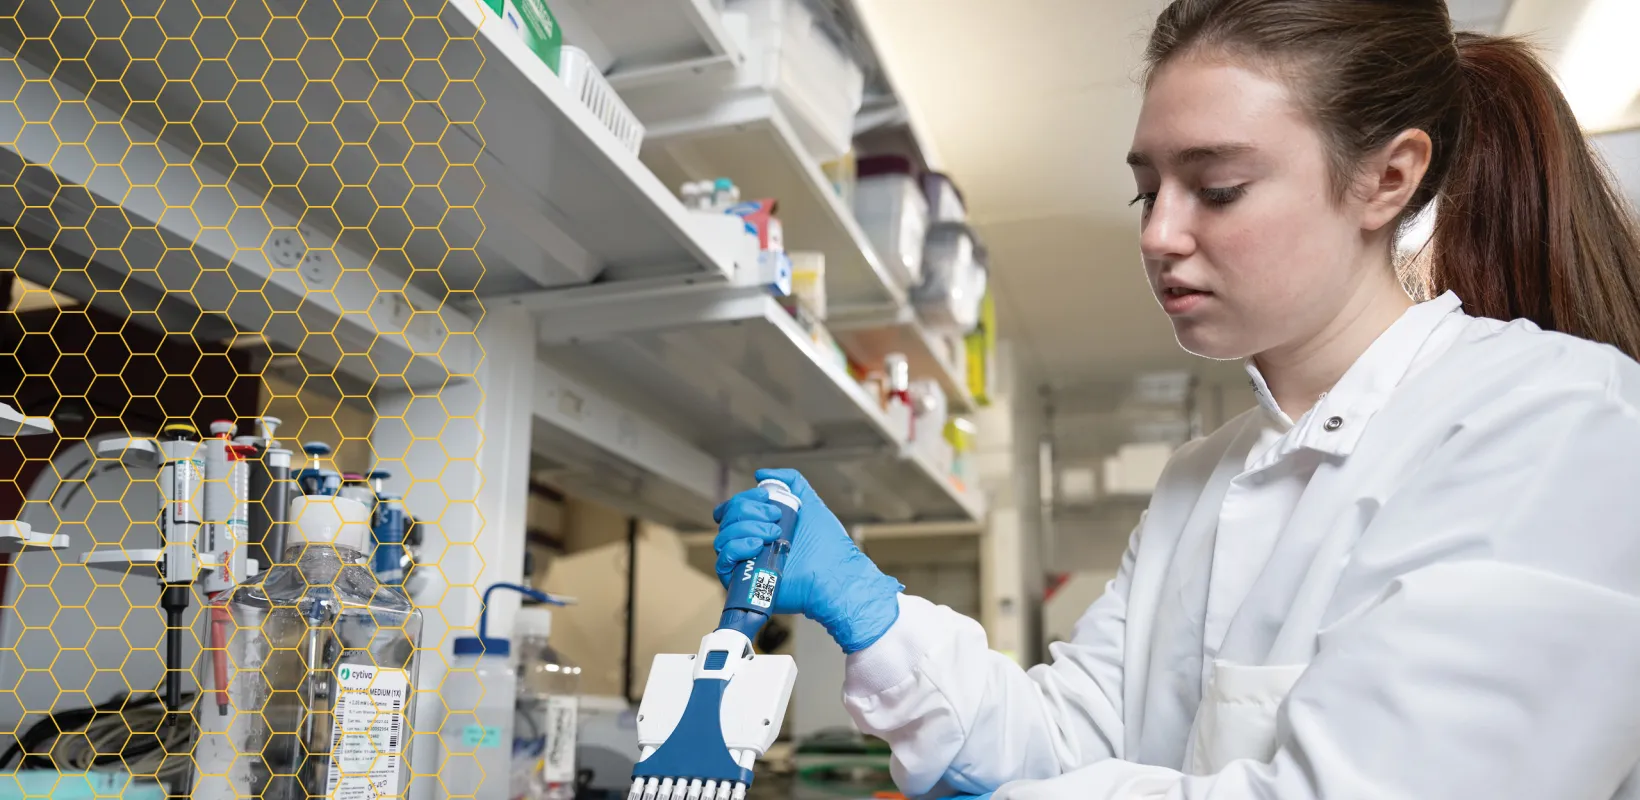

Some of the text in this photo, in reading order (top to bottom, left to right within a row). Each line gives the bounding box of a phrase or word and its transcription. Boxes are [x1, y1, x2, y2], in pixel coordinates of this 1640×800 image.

[742, 557, 757, 581] VW
[352, 670, 373, 680] cytiva
[369, 688, 391, 697] MEDIUM
